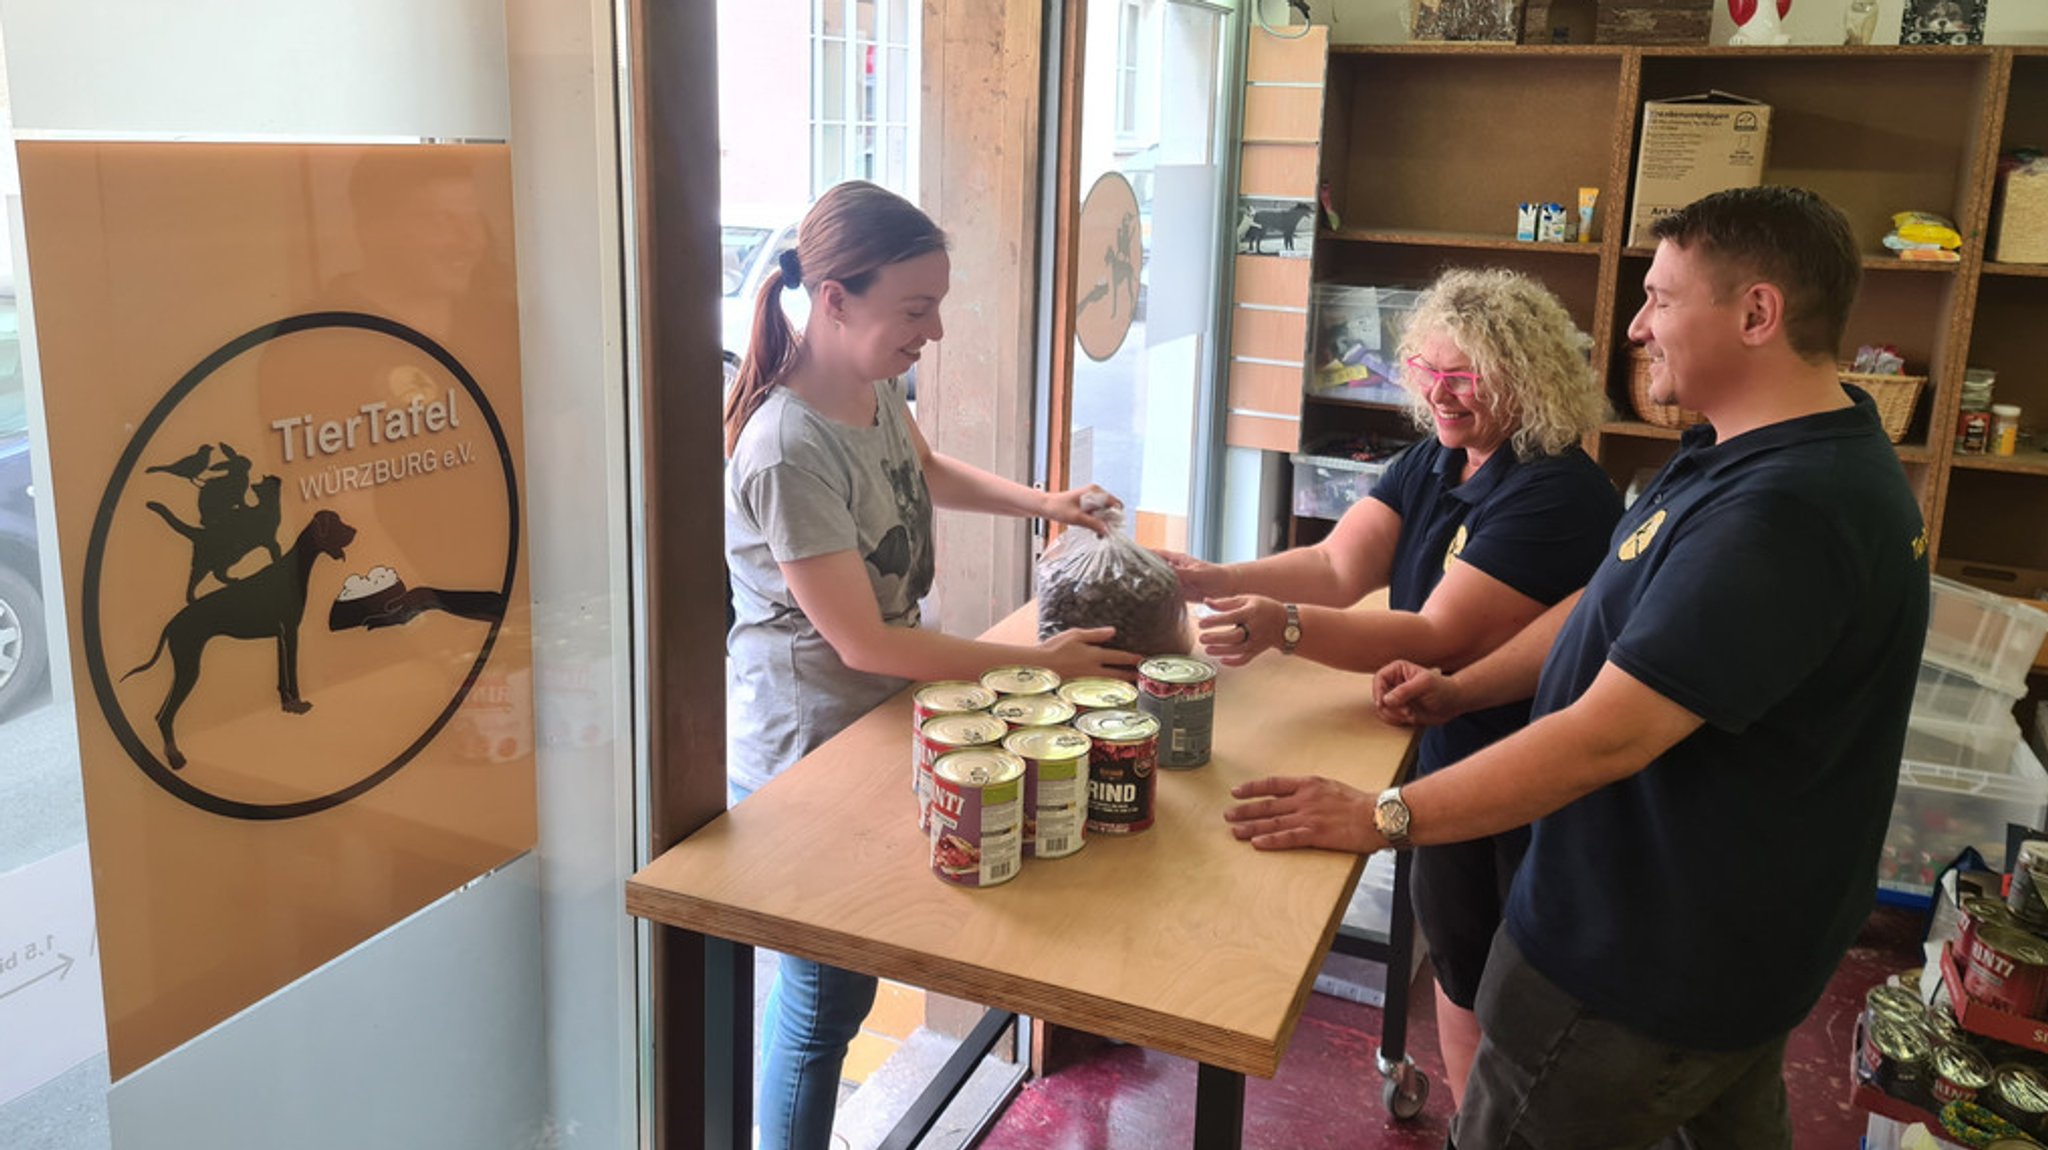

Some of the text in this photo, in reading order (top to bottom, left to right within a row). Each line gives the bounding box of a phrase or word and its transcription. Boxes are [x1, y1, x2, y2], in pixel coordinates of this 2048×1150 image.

[272, 389, 460, 462] TierTafel
[300, 442, 476, 501] WÜRZBURG e.V.
